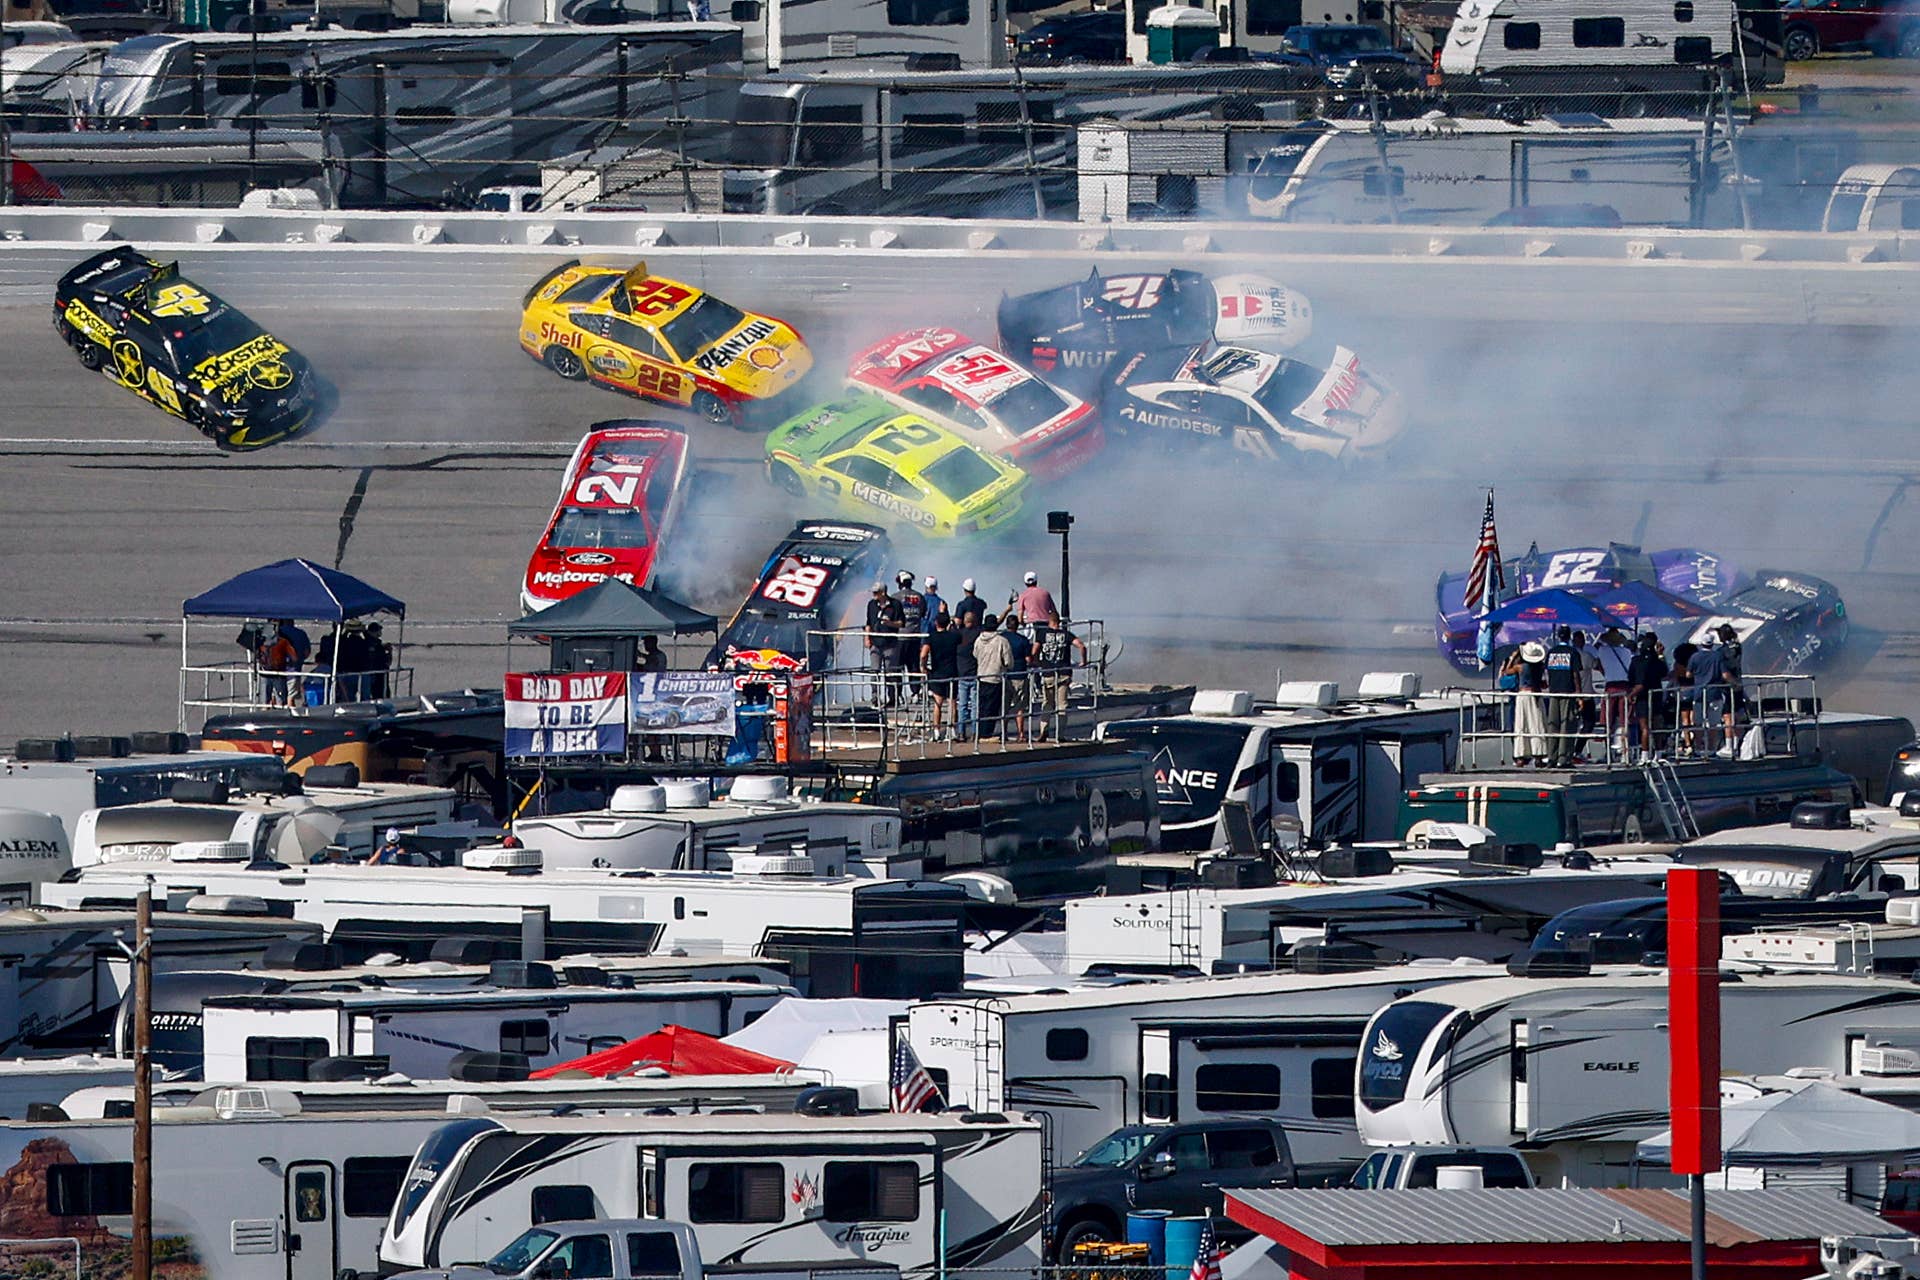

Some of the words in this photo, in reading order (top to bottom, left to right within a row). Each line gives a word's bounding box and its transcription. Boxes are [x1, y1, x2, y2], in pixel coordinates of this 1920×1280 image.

[540, 321, 583, 349] Shell
[695, 320, 776, 376] PENNZOIL
[638, 364, 681, 397] 22
[1136, 410, 1223, 438] AUTODESK
[852, 479, 936, 528] MENARDS
[522, 677, 561, 700] BAD
[569, 675, 607, 699] DAY
[637, 672, 658, 702] 1
[658, 679, 731, 692] CHASTAIN
[538, 705, 560, 726] TO
[570, 704, 592, 725] BE
[530, 729, 544, 753] A
[552, 729, 598, 753] BEER
[0, 840, 60, 853] ALEM
[1583, 1061, 1641, 1072] EAGLE
[834, 1224, 910, 1252] Imagine
